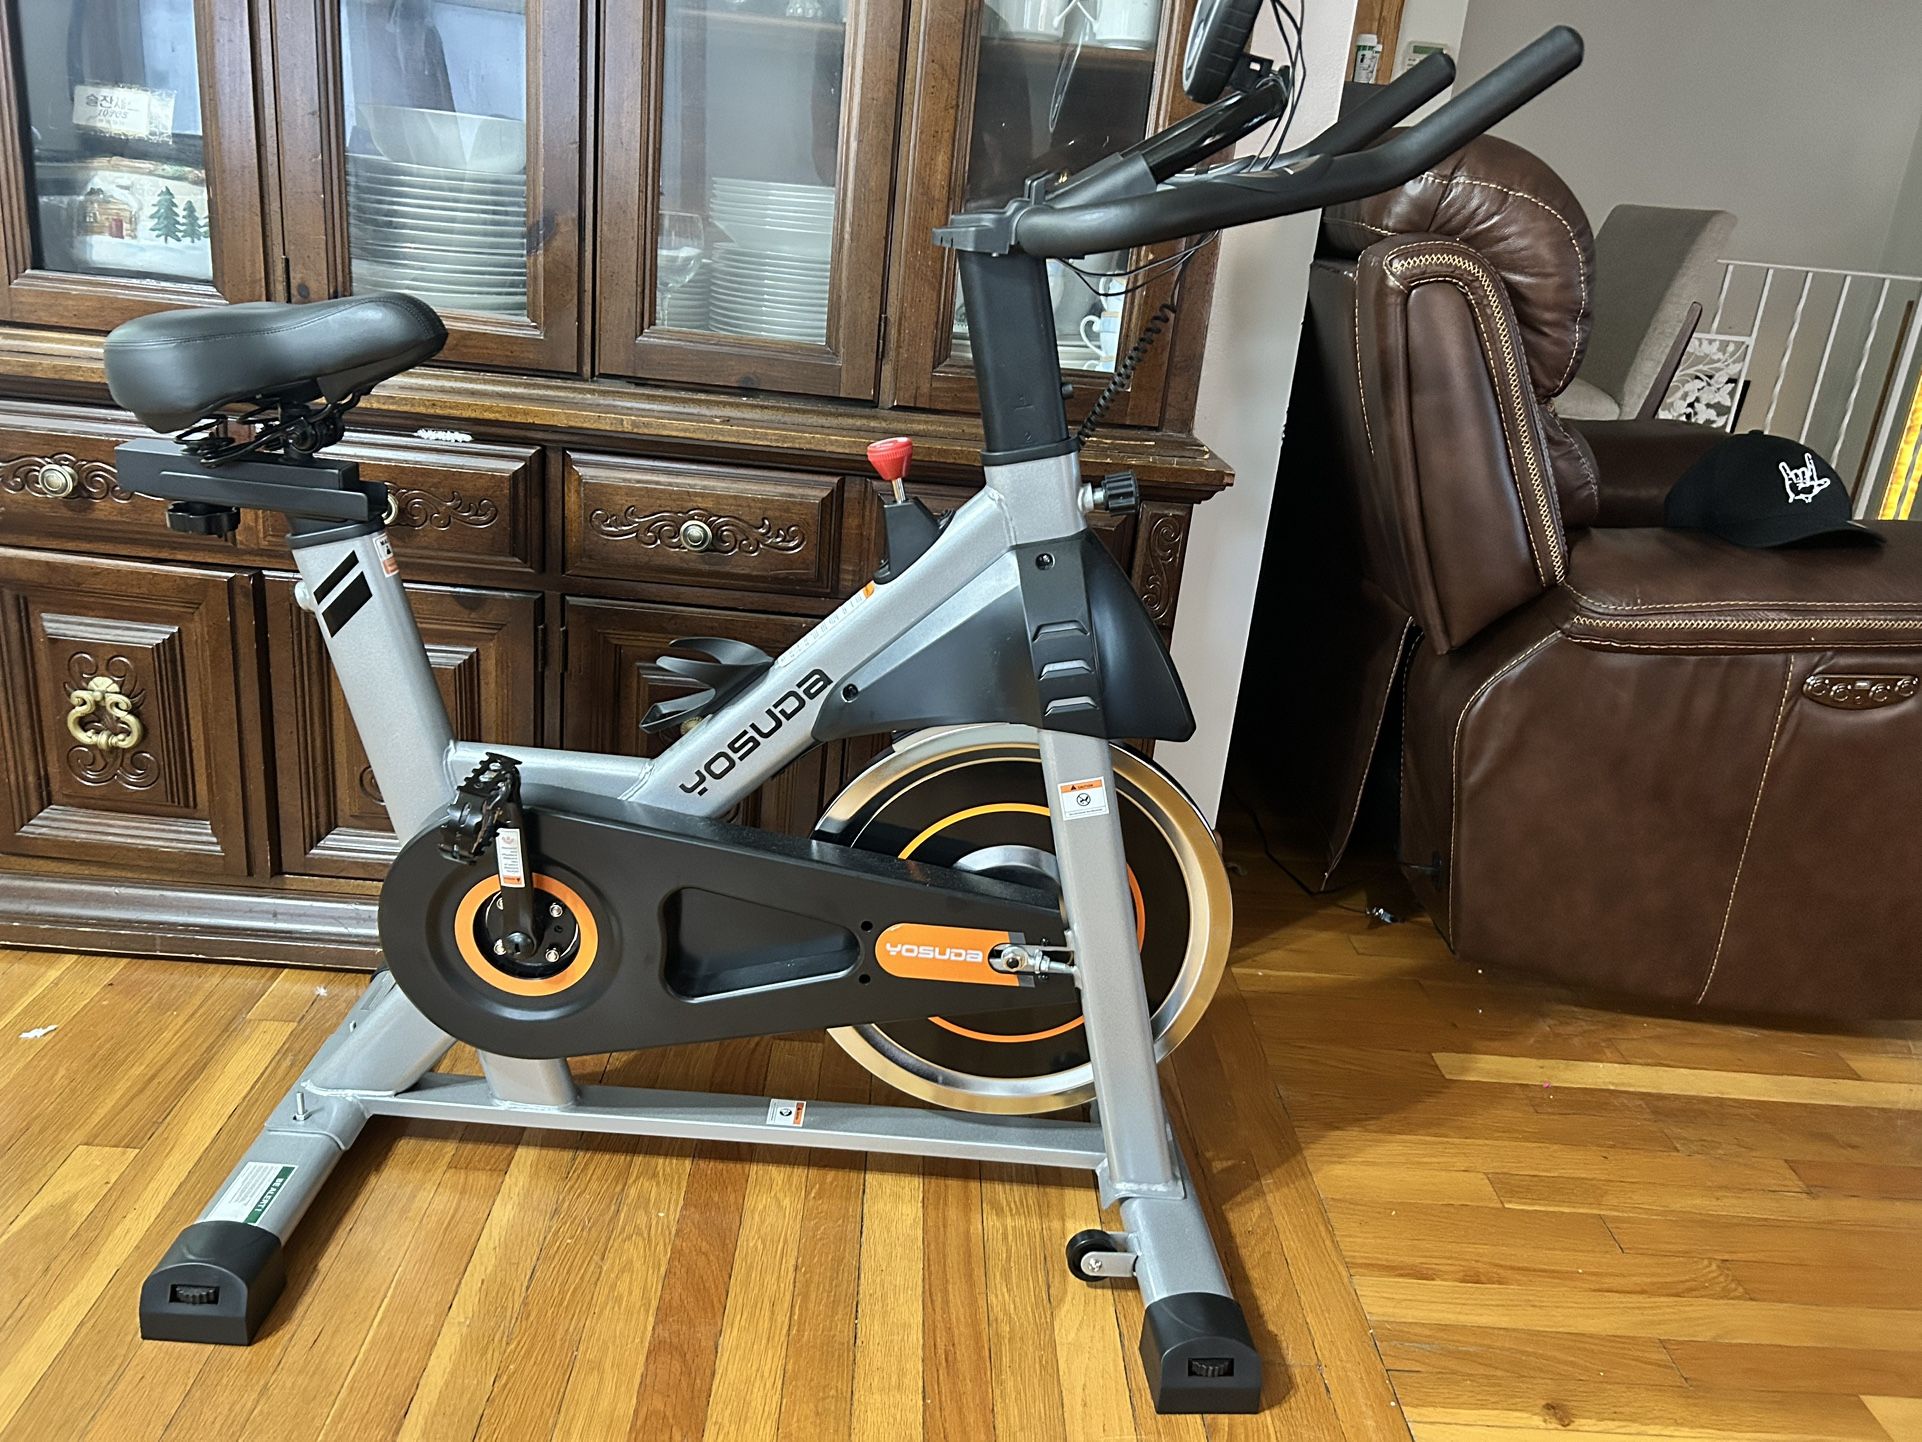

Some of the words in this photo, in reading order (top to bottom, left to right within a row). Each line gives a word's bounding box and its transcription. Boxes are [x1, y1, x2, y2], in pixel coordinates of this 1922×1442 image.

[679, 668, 834, 797] YOSUDA
[885, 942, 983, 963] YOSUDA
[273, 1177, 284, 1189] BE
